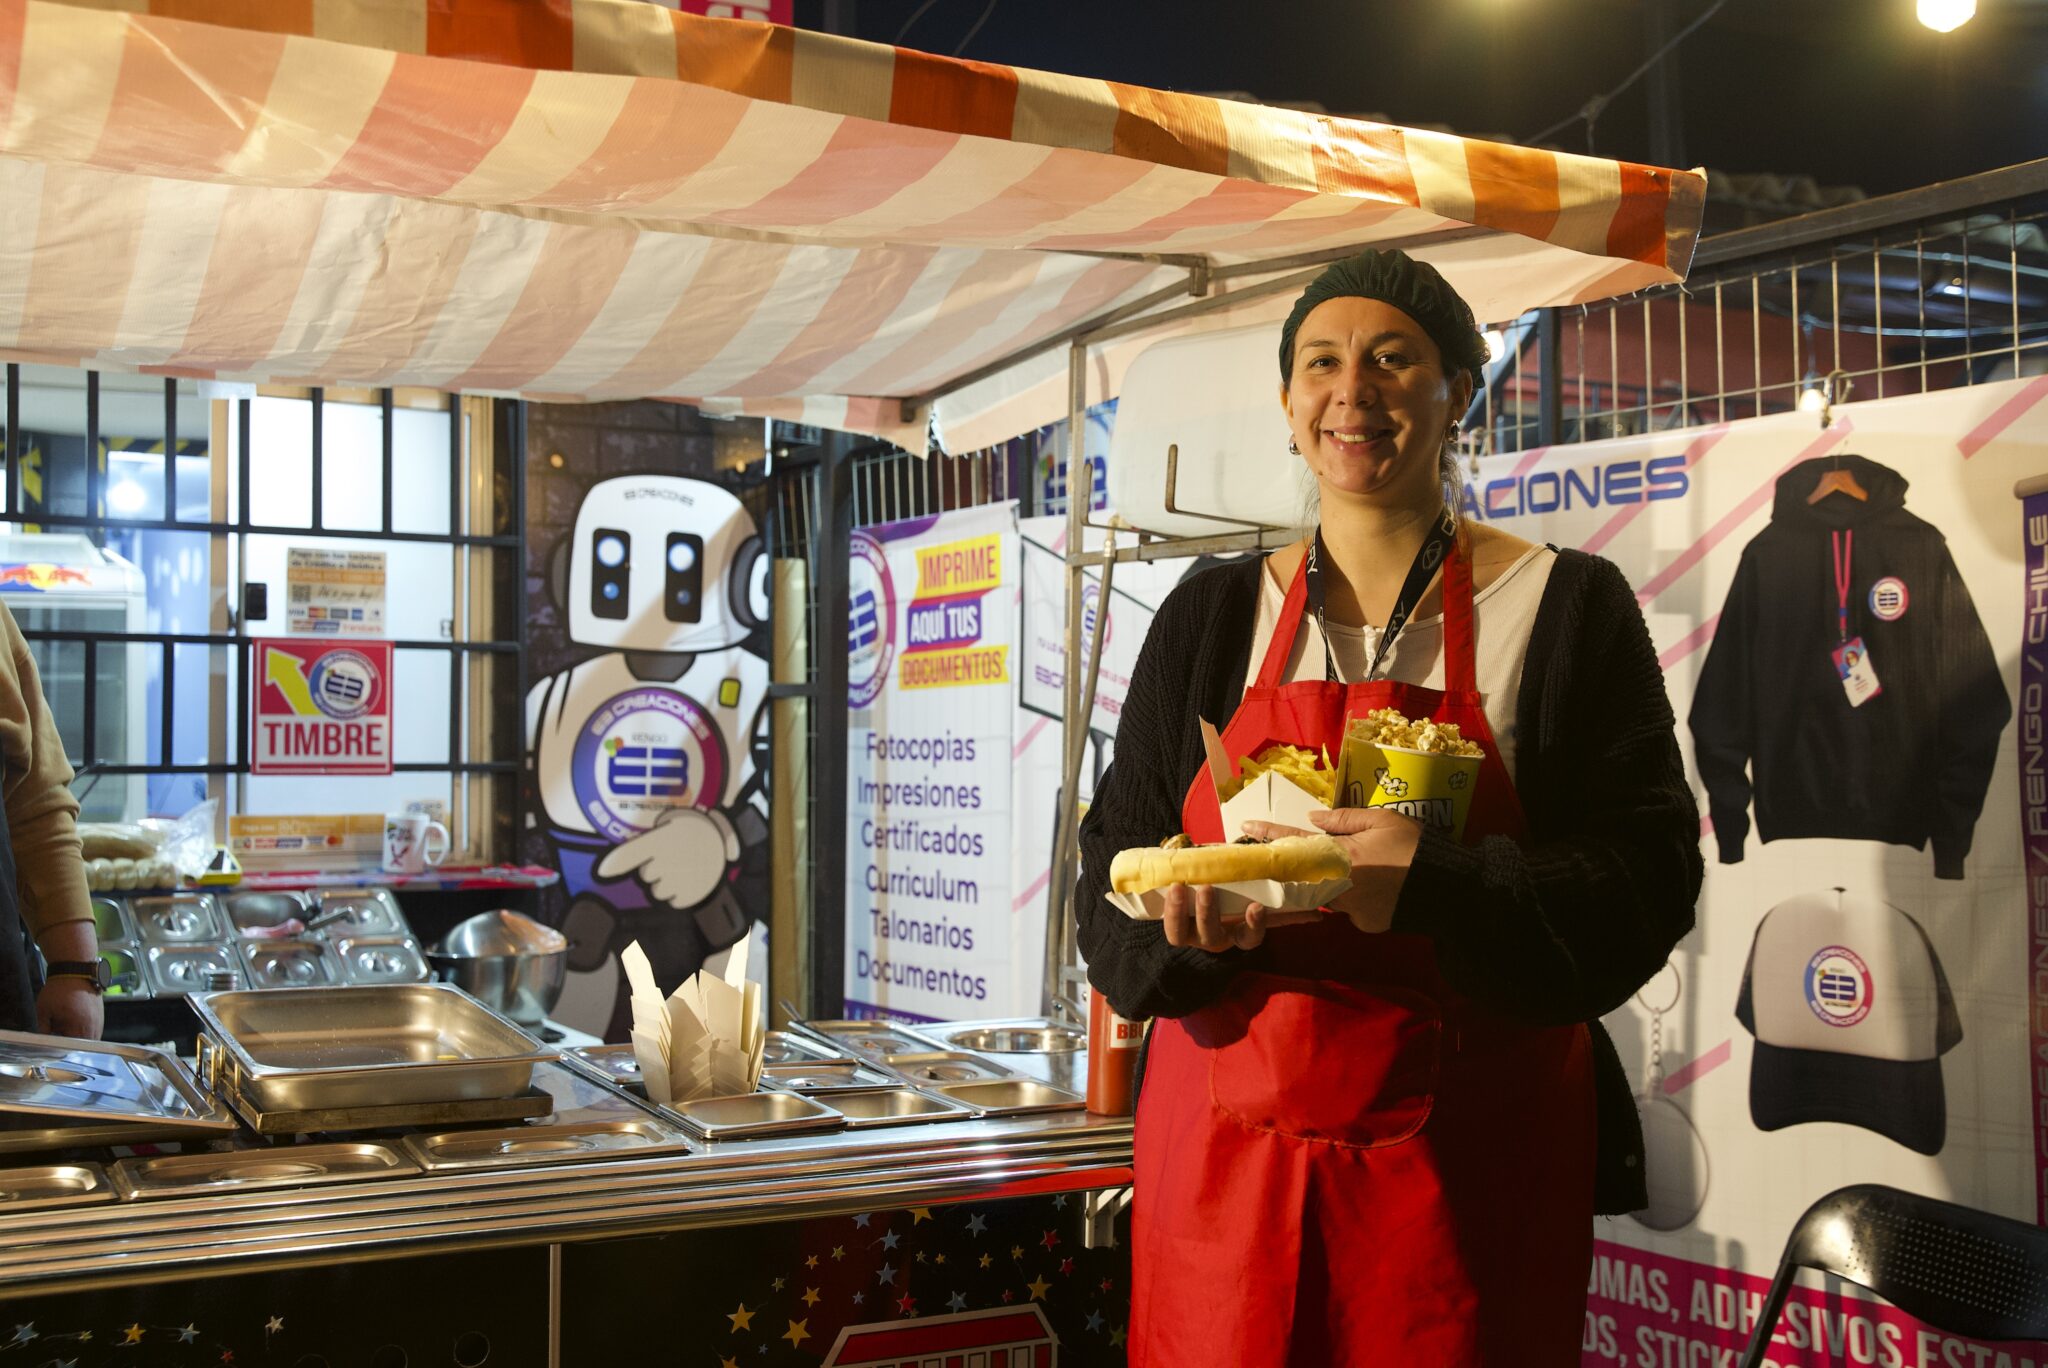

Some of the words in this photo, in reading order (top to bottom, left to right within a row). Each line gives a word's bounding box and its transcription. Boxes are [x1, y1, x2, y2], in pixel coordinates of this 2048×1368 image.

[1446, 455, 1688, 520] ACIONES
[923, 546, 996, 589] IMPRIME
[2028, 514, 2048, 645] CHILE
[910, 602, 946, 643] AQUÍ
[947, 605, 978, 639] TUS
[903, 651, 1002, 685] DOCUMENTOS
[263, 722, 382, 756] TIMBRE
[866, 729, 976, 768] Fotocopias
[2024, 683, 2048, 836] RENGO
[857, 776, 981, 812] Impresiones
[861, 819, 984, 857] Certificados
[866, 864, 978, 904] Curriculum
[869, 908, 974, 951] Talonarios
[857, 950, 986, 1001] Documentos
